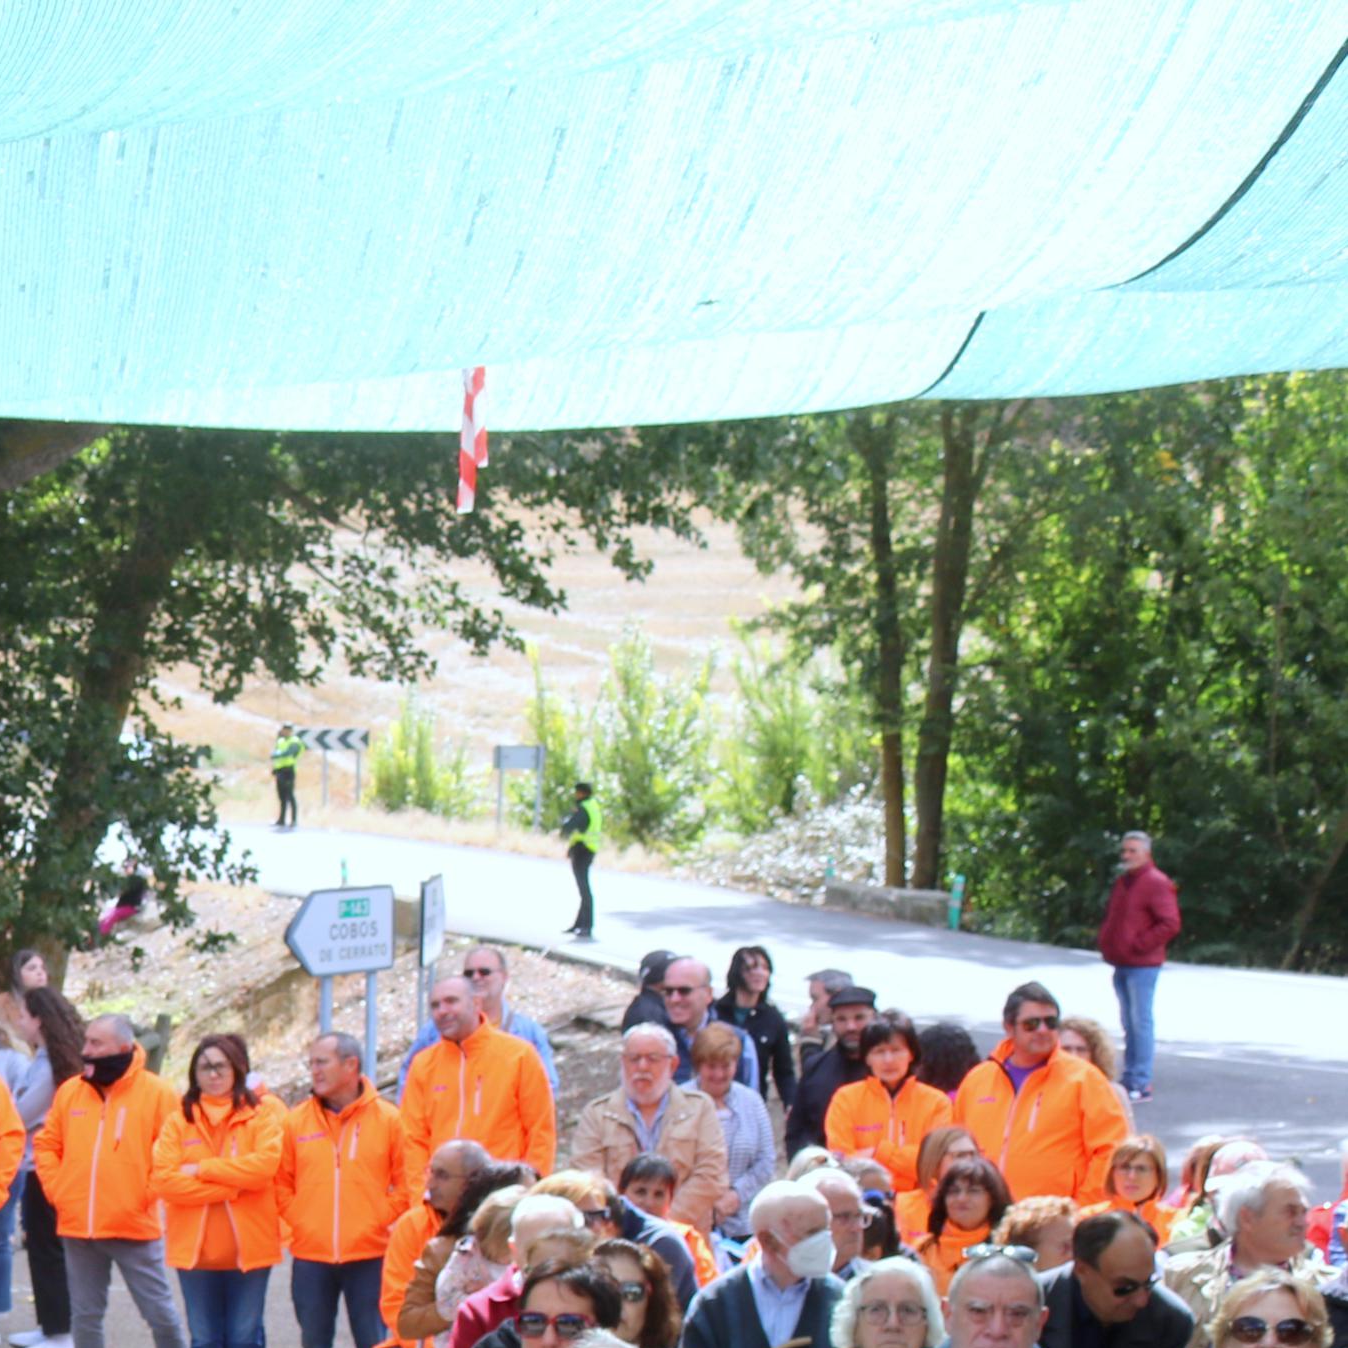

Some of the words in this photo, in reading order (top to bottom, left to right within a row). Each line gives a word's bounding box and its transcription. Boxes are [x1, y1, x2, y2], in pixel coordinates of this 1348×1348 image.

[329, 922, 378, 940] COBOS
[319, 949, 333, 962] DE
[339, 944, 387, 960] CERRATO
